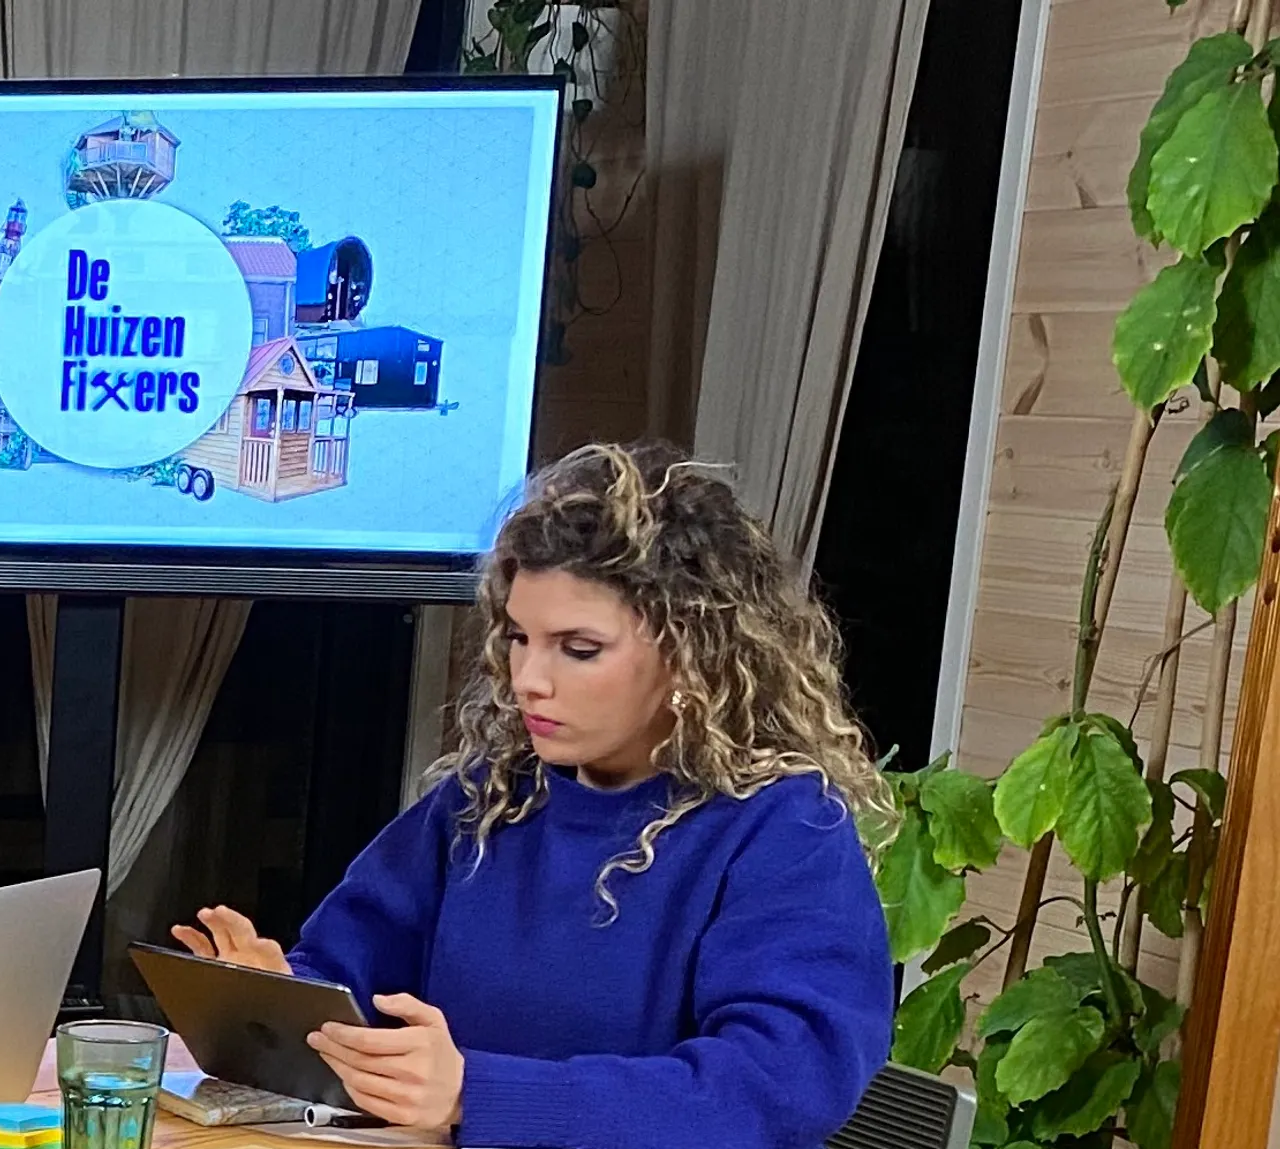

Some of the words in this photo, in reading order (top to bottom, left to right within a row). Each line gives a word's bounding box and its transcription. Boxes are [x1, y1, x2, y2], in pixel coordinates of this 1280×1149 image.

[67, 249, 110, 301] De
[63, 305, 186, 358] Huizen
[61, 360, 201, 413] Fixers
